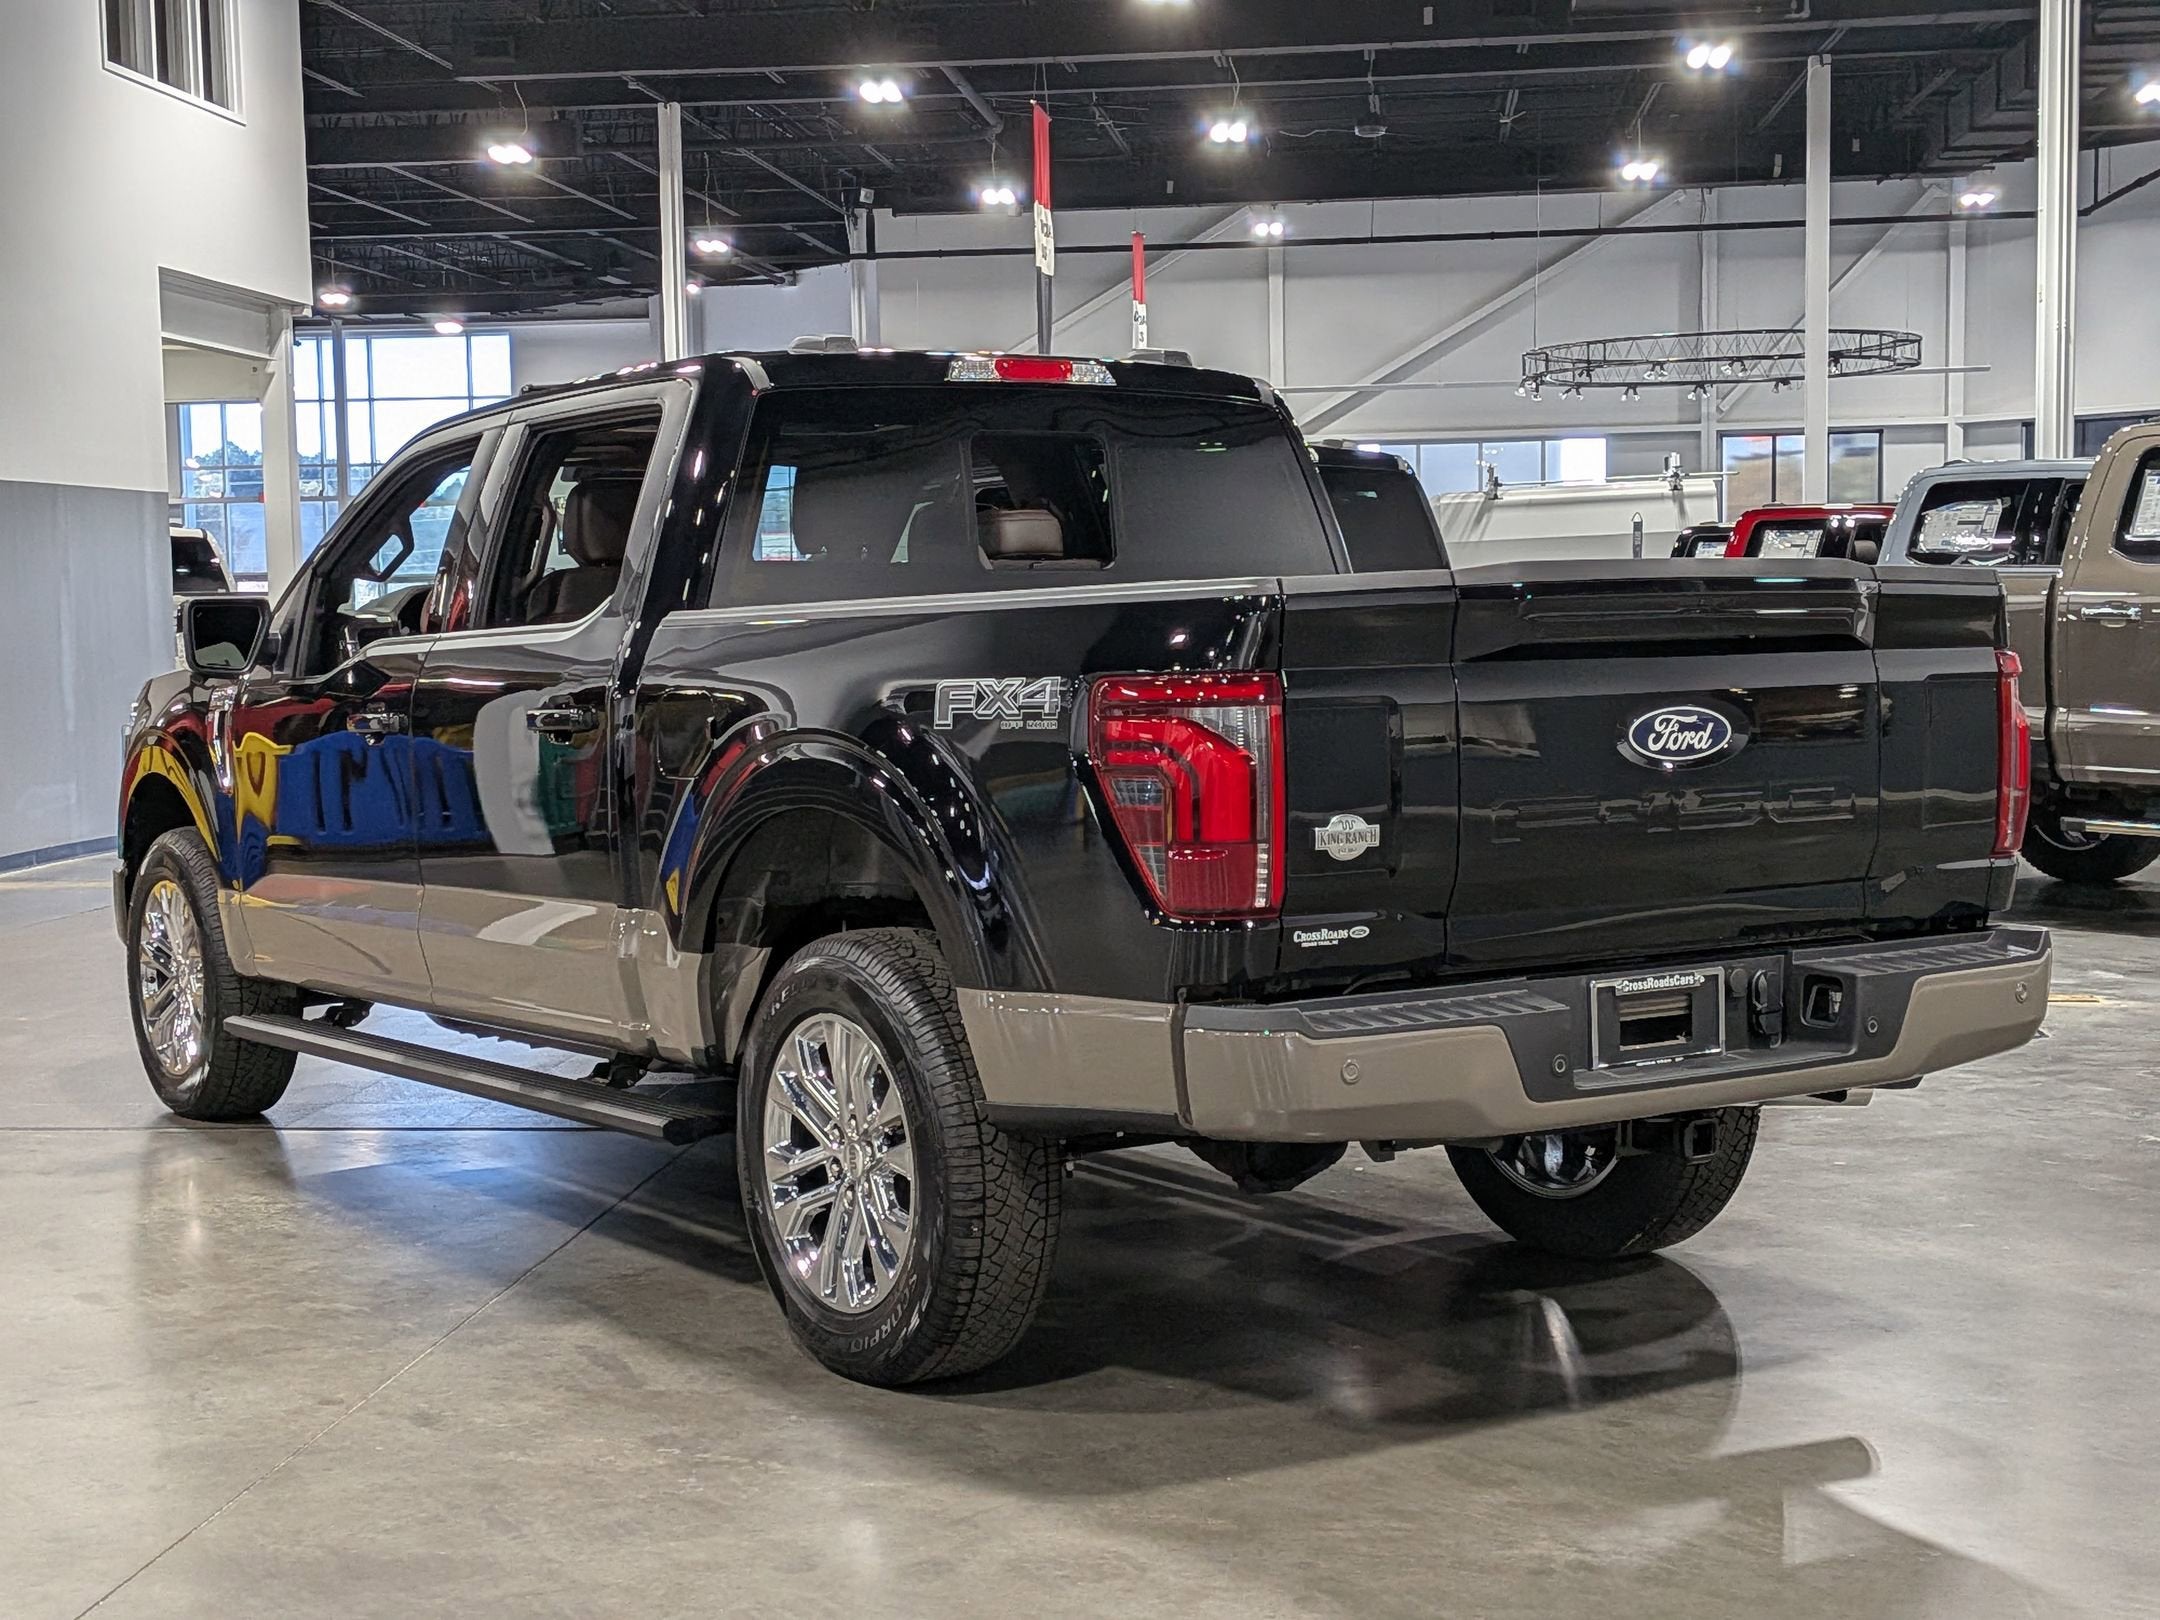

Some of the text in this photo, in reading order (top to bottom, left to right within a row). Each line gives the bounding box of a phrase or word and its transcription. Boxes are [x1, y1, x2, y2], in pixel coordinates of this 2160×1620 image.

[934, 676, 1061, 729] FX4
[1647, 714, 1714, 751] Ford
[1320, 828, 1377, 846] KING RANCH
